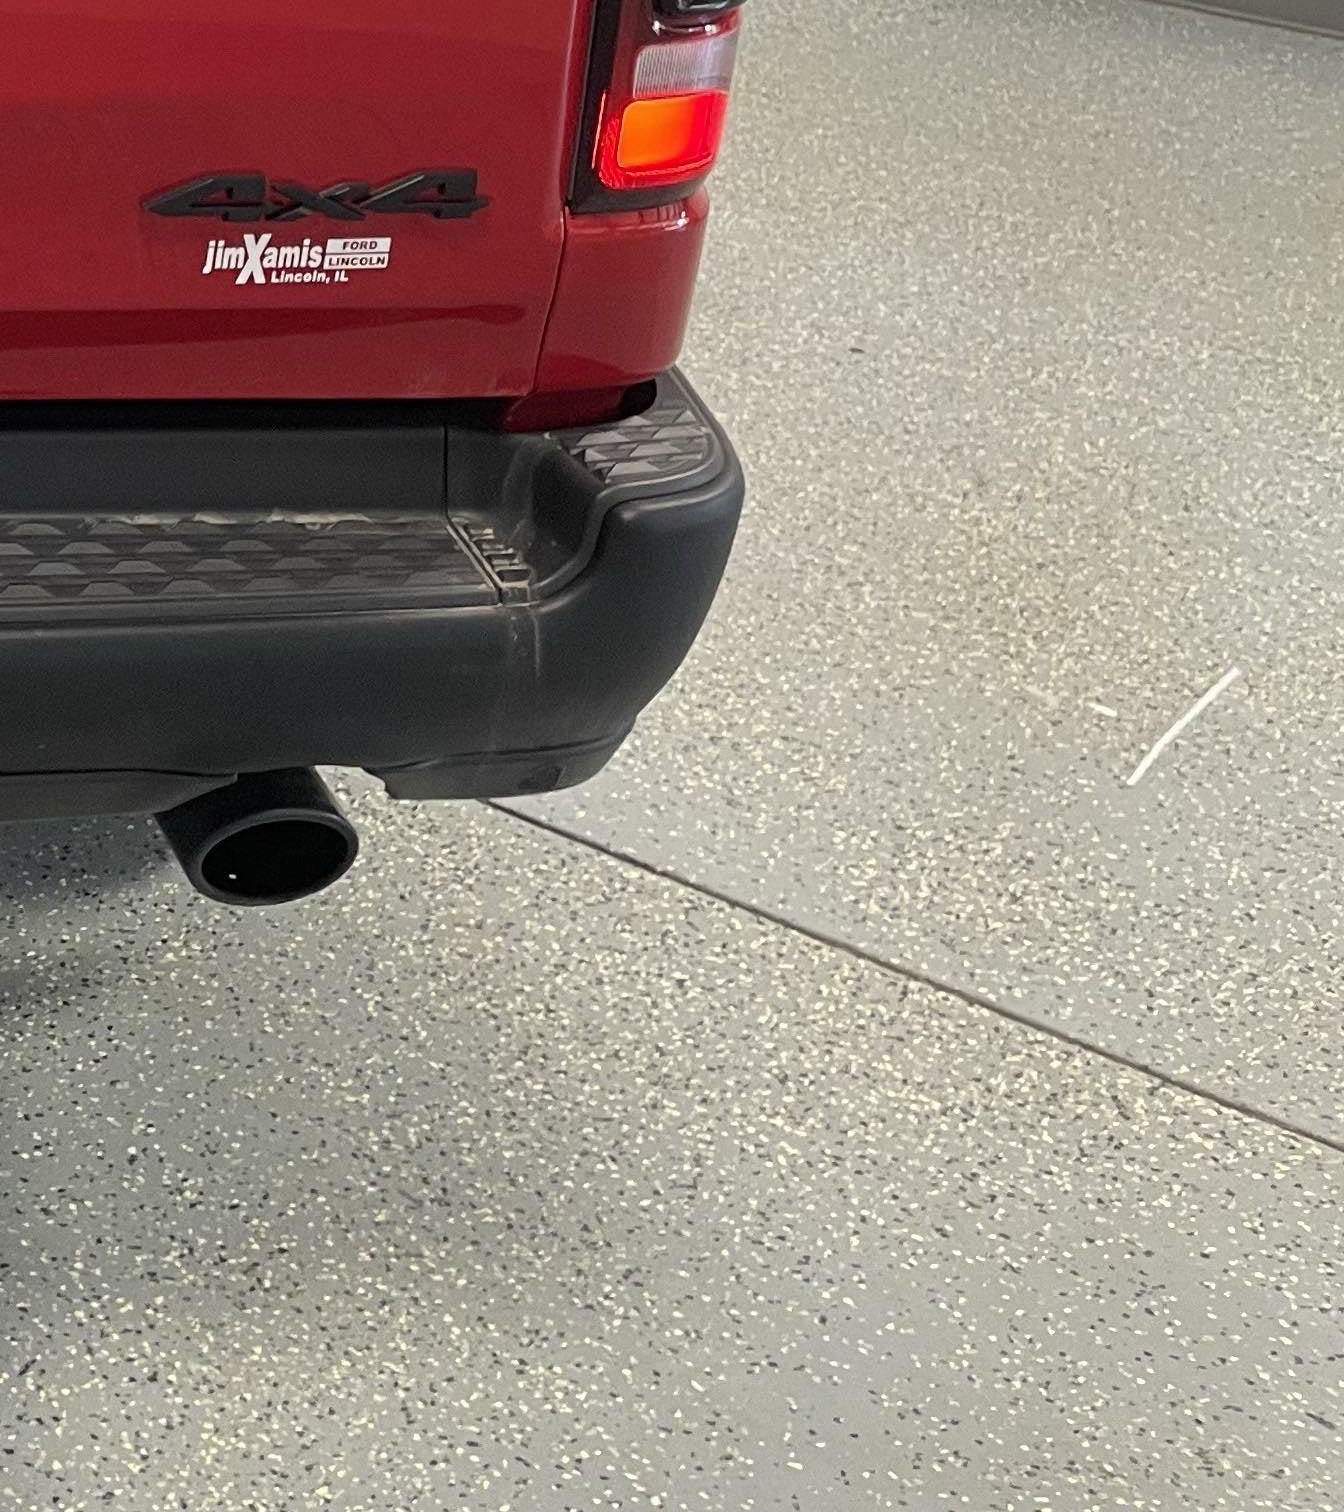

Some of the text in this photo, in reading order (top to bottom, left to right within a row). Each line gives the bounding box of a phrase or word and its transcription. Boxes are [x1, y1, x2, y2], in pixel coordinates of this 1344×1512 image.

[342, 240, 378, 251] FORD
[328, 256, 386, 268] LINCOLN
[271, 269, 349, 285] Lincoln, IL
